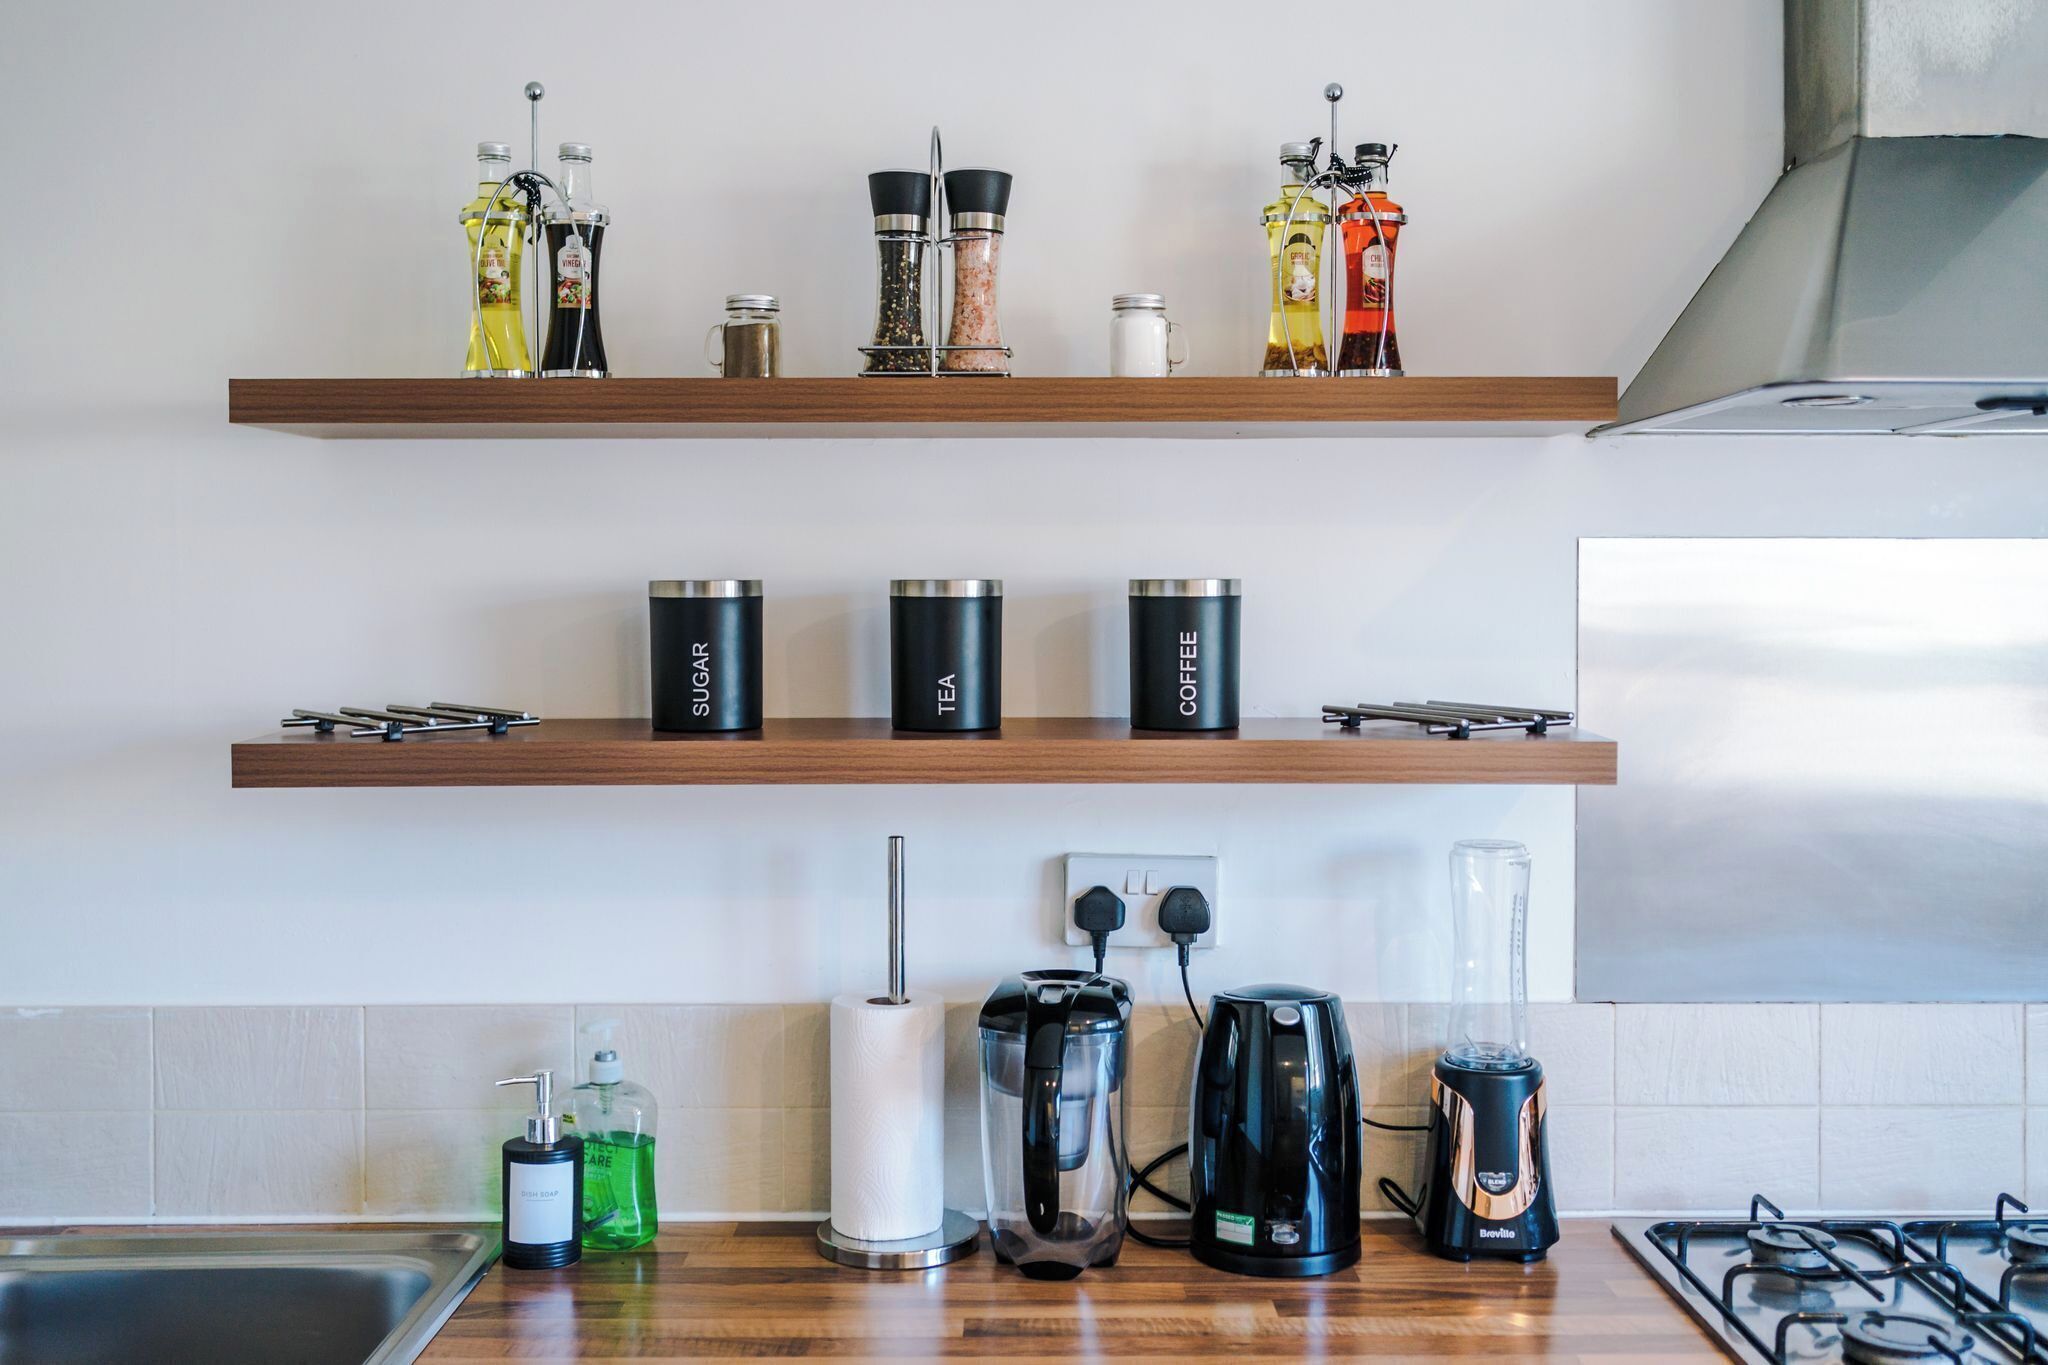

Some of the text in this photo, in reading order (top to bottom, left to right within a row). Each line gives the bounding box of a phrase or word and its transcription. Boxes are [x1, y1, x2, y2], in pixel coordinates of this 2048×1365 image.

[480, 259, 495, 267] OLIVE
[692, 642, 710, 717] SUGAR
[1179, 631, 1197, 716] COFFEE
[937, 673, 956, 716] TEA
[540, 1190, 559, 1198] SOAP
[1479, 1228, 1516, 1239] Breville
